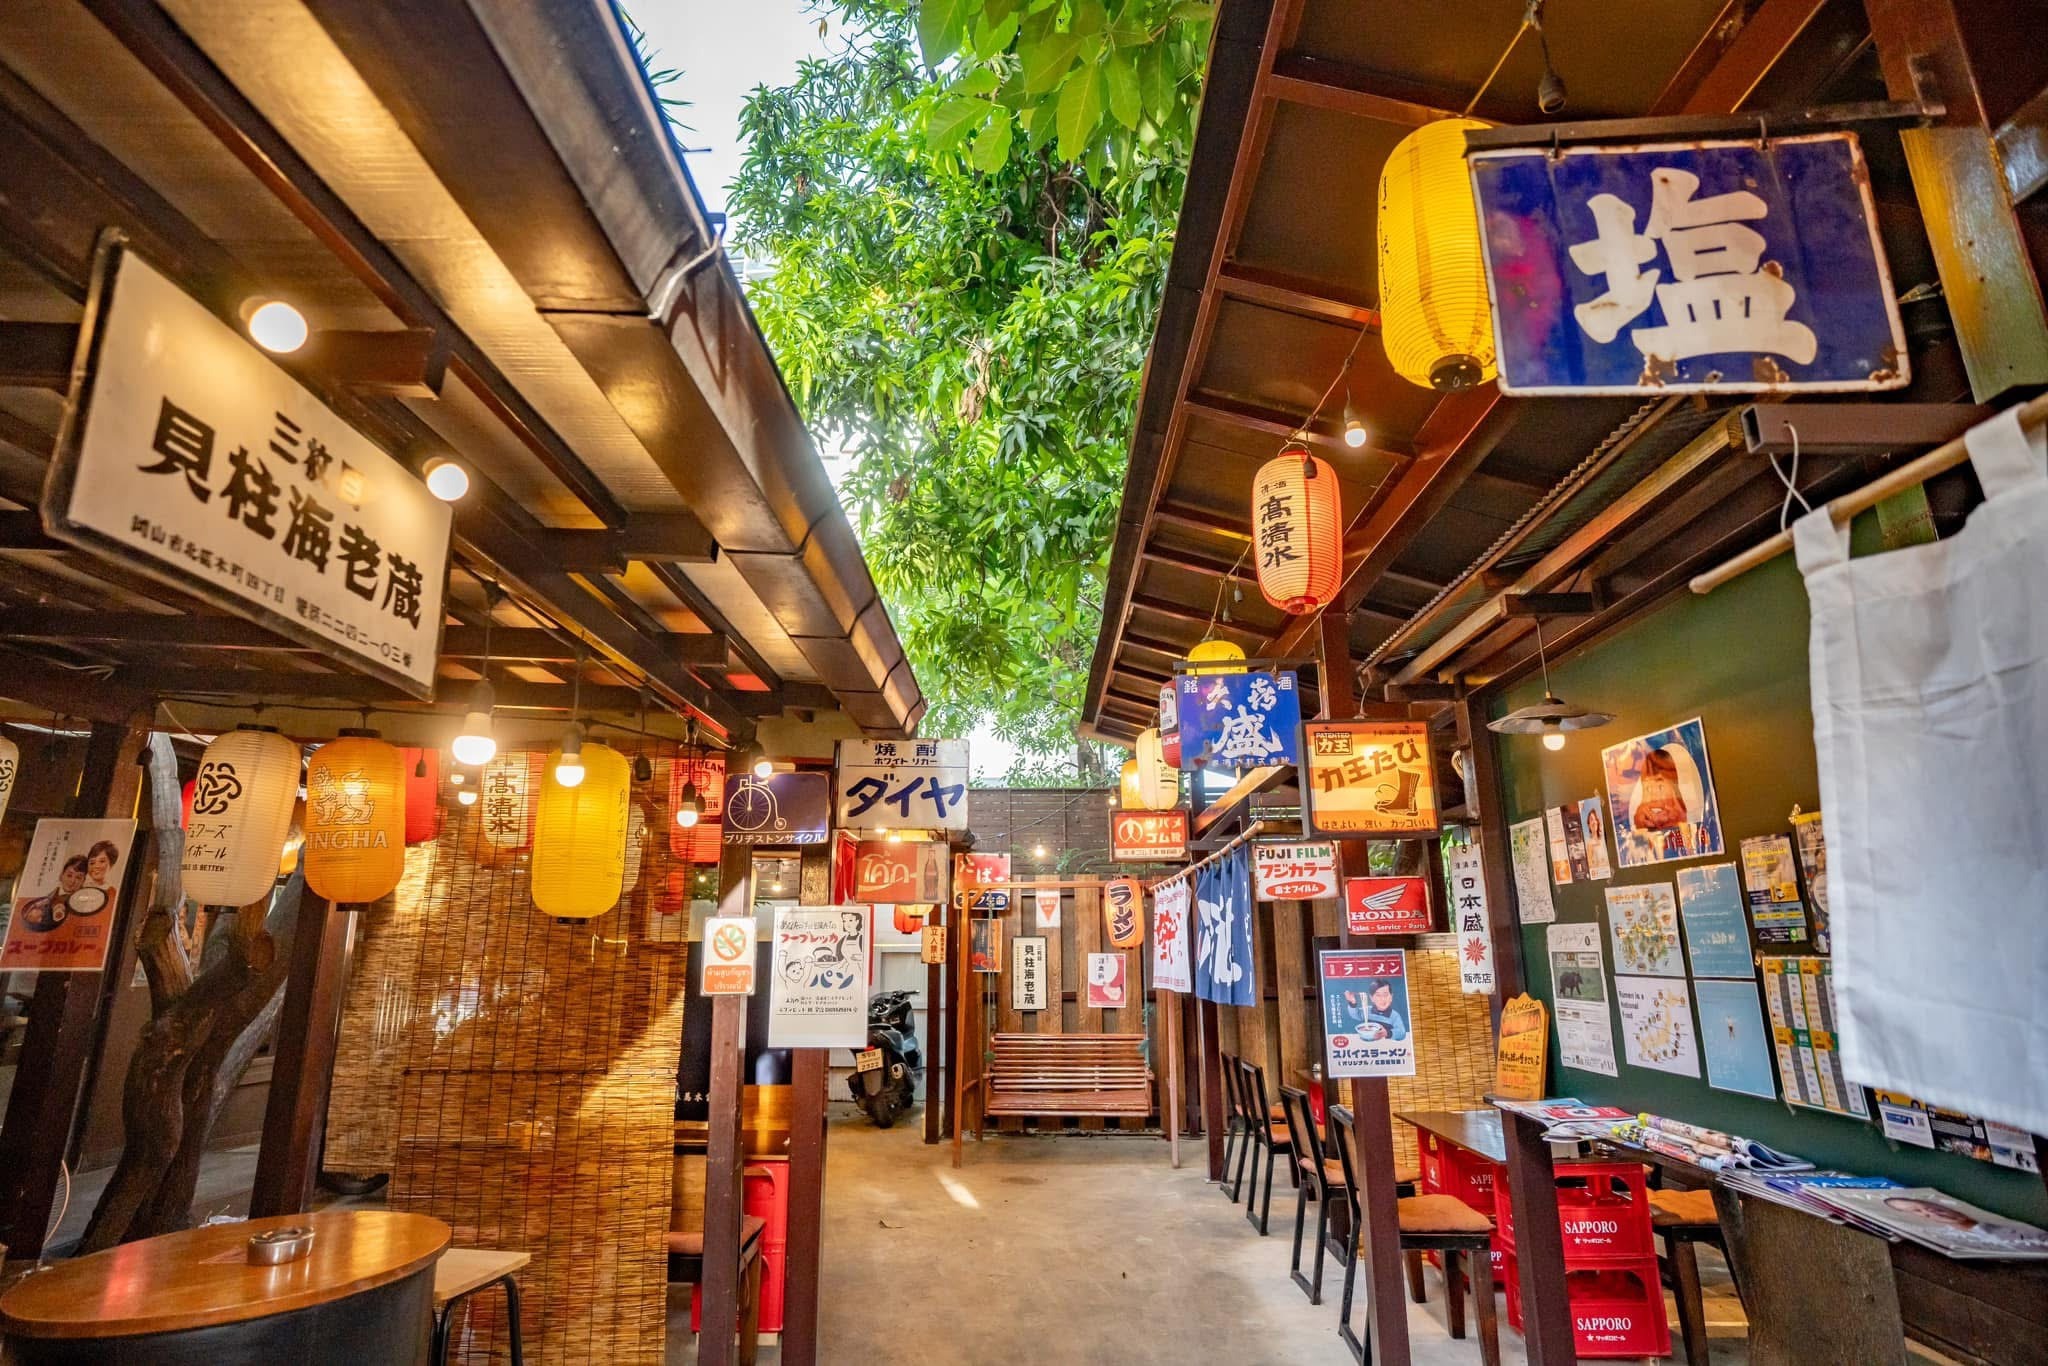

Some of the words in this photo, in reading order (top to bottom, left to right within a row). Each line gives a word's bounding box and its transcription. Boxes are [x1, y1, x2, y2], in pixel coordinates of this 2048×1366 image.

[1569, 166, 1816, 365] 塩
[846, 773, 965, 818] ダイヤ
[1321, 820, 1357, 829] はきよい
[1258, 849, 1291, 860] FUJI
[1296, 847, 1330, 858] FILM
[1260, 862, 1331, 878] フジカラー
[1110, 885, 1135, 940] ラーメン
[1351, 910, 1425, 921] HONDA
[1343, 962, 1400, 976] ラーメン
[809, 969, 854, 990] パン
[1464, 973, 1492, 985] 販売店
[1470, 1173, 1494, 1185] SAPP
[1565, 1221, 1618, 1234] SAPPORO
[1577, 1317, 1632, 1331] SAPPORO
